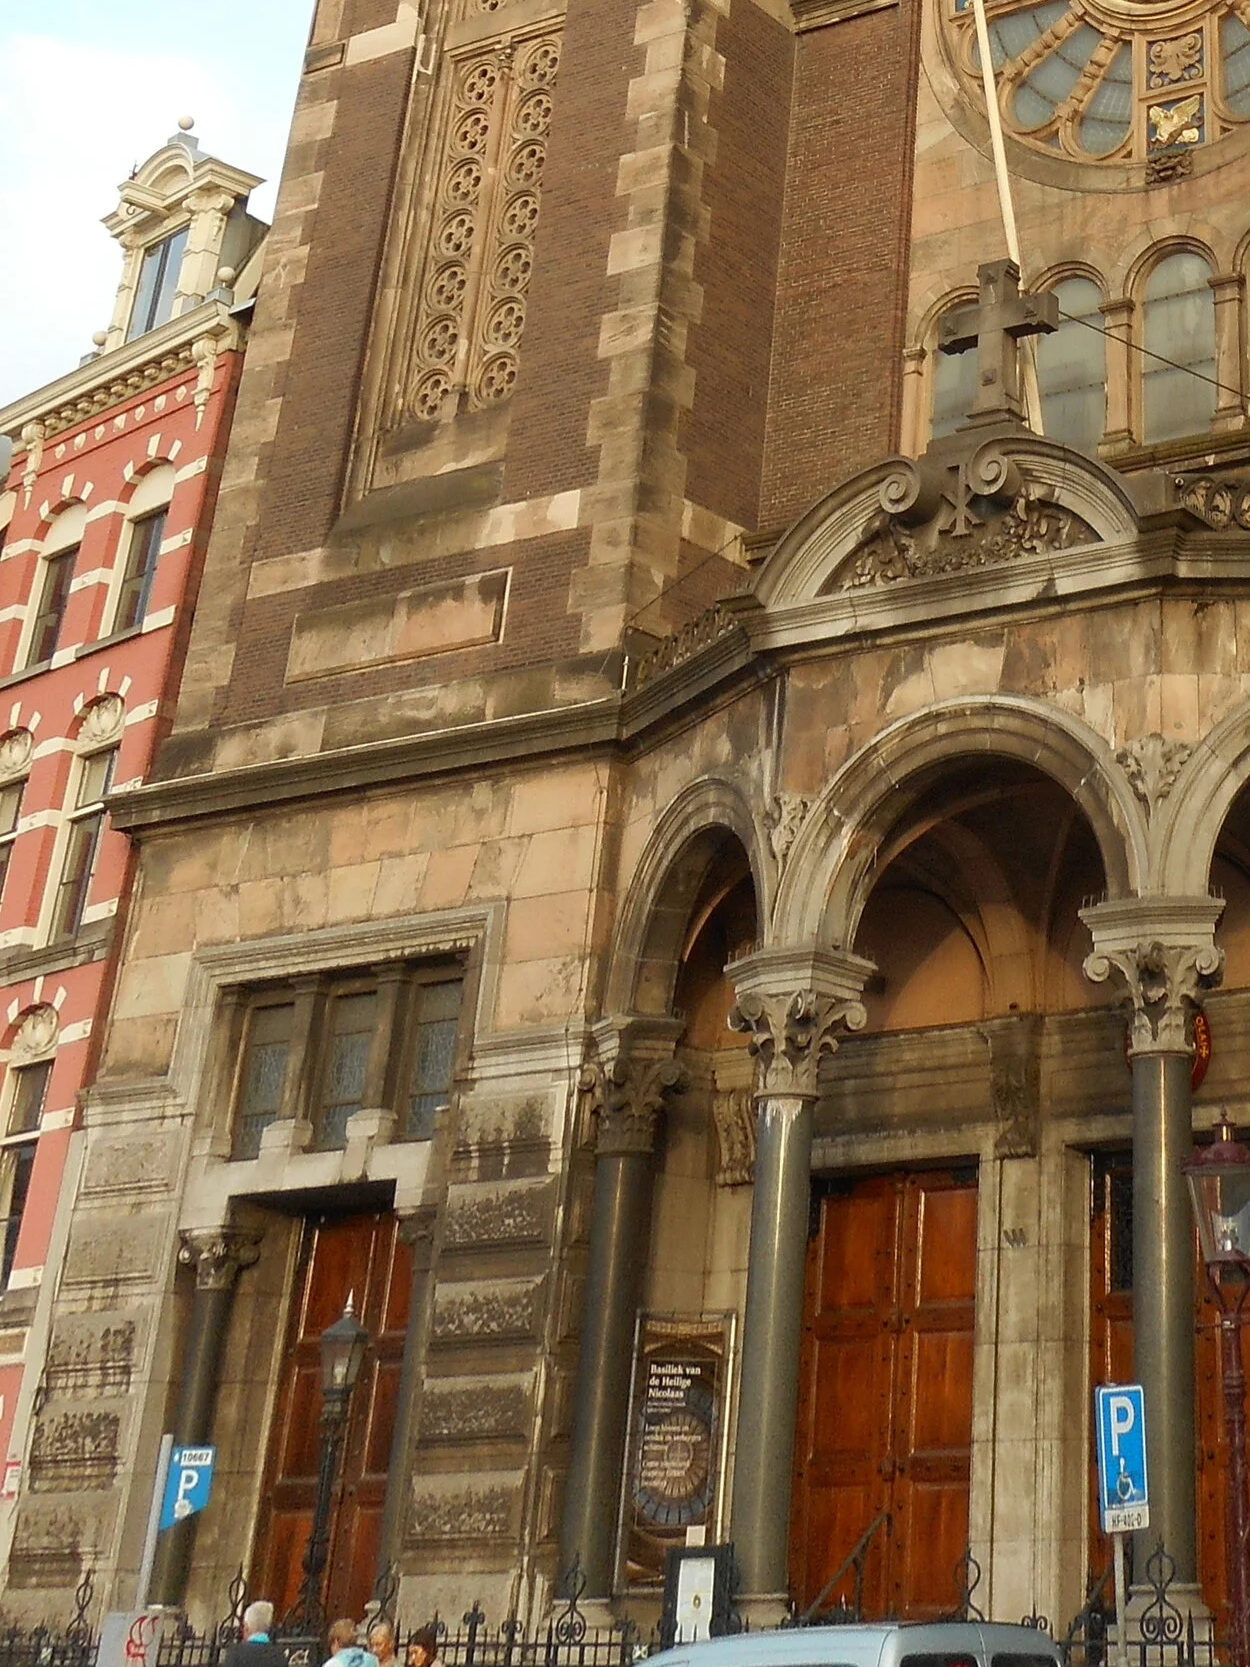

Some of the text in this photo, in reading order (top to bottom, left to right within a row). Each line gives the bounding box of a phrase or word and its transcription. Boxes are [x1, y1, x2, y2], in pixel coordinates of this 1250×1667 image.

[650, 1364, 701, 1376] Basiliek van
[649, 1376, 691, 1389] de Heilige
[648, 1388, 684, 1399] Nicolaas
[1109, 1396, 1135, 1457] P
[178, 1469, 199, 1501] P
